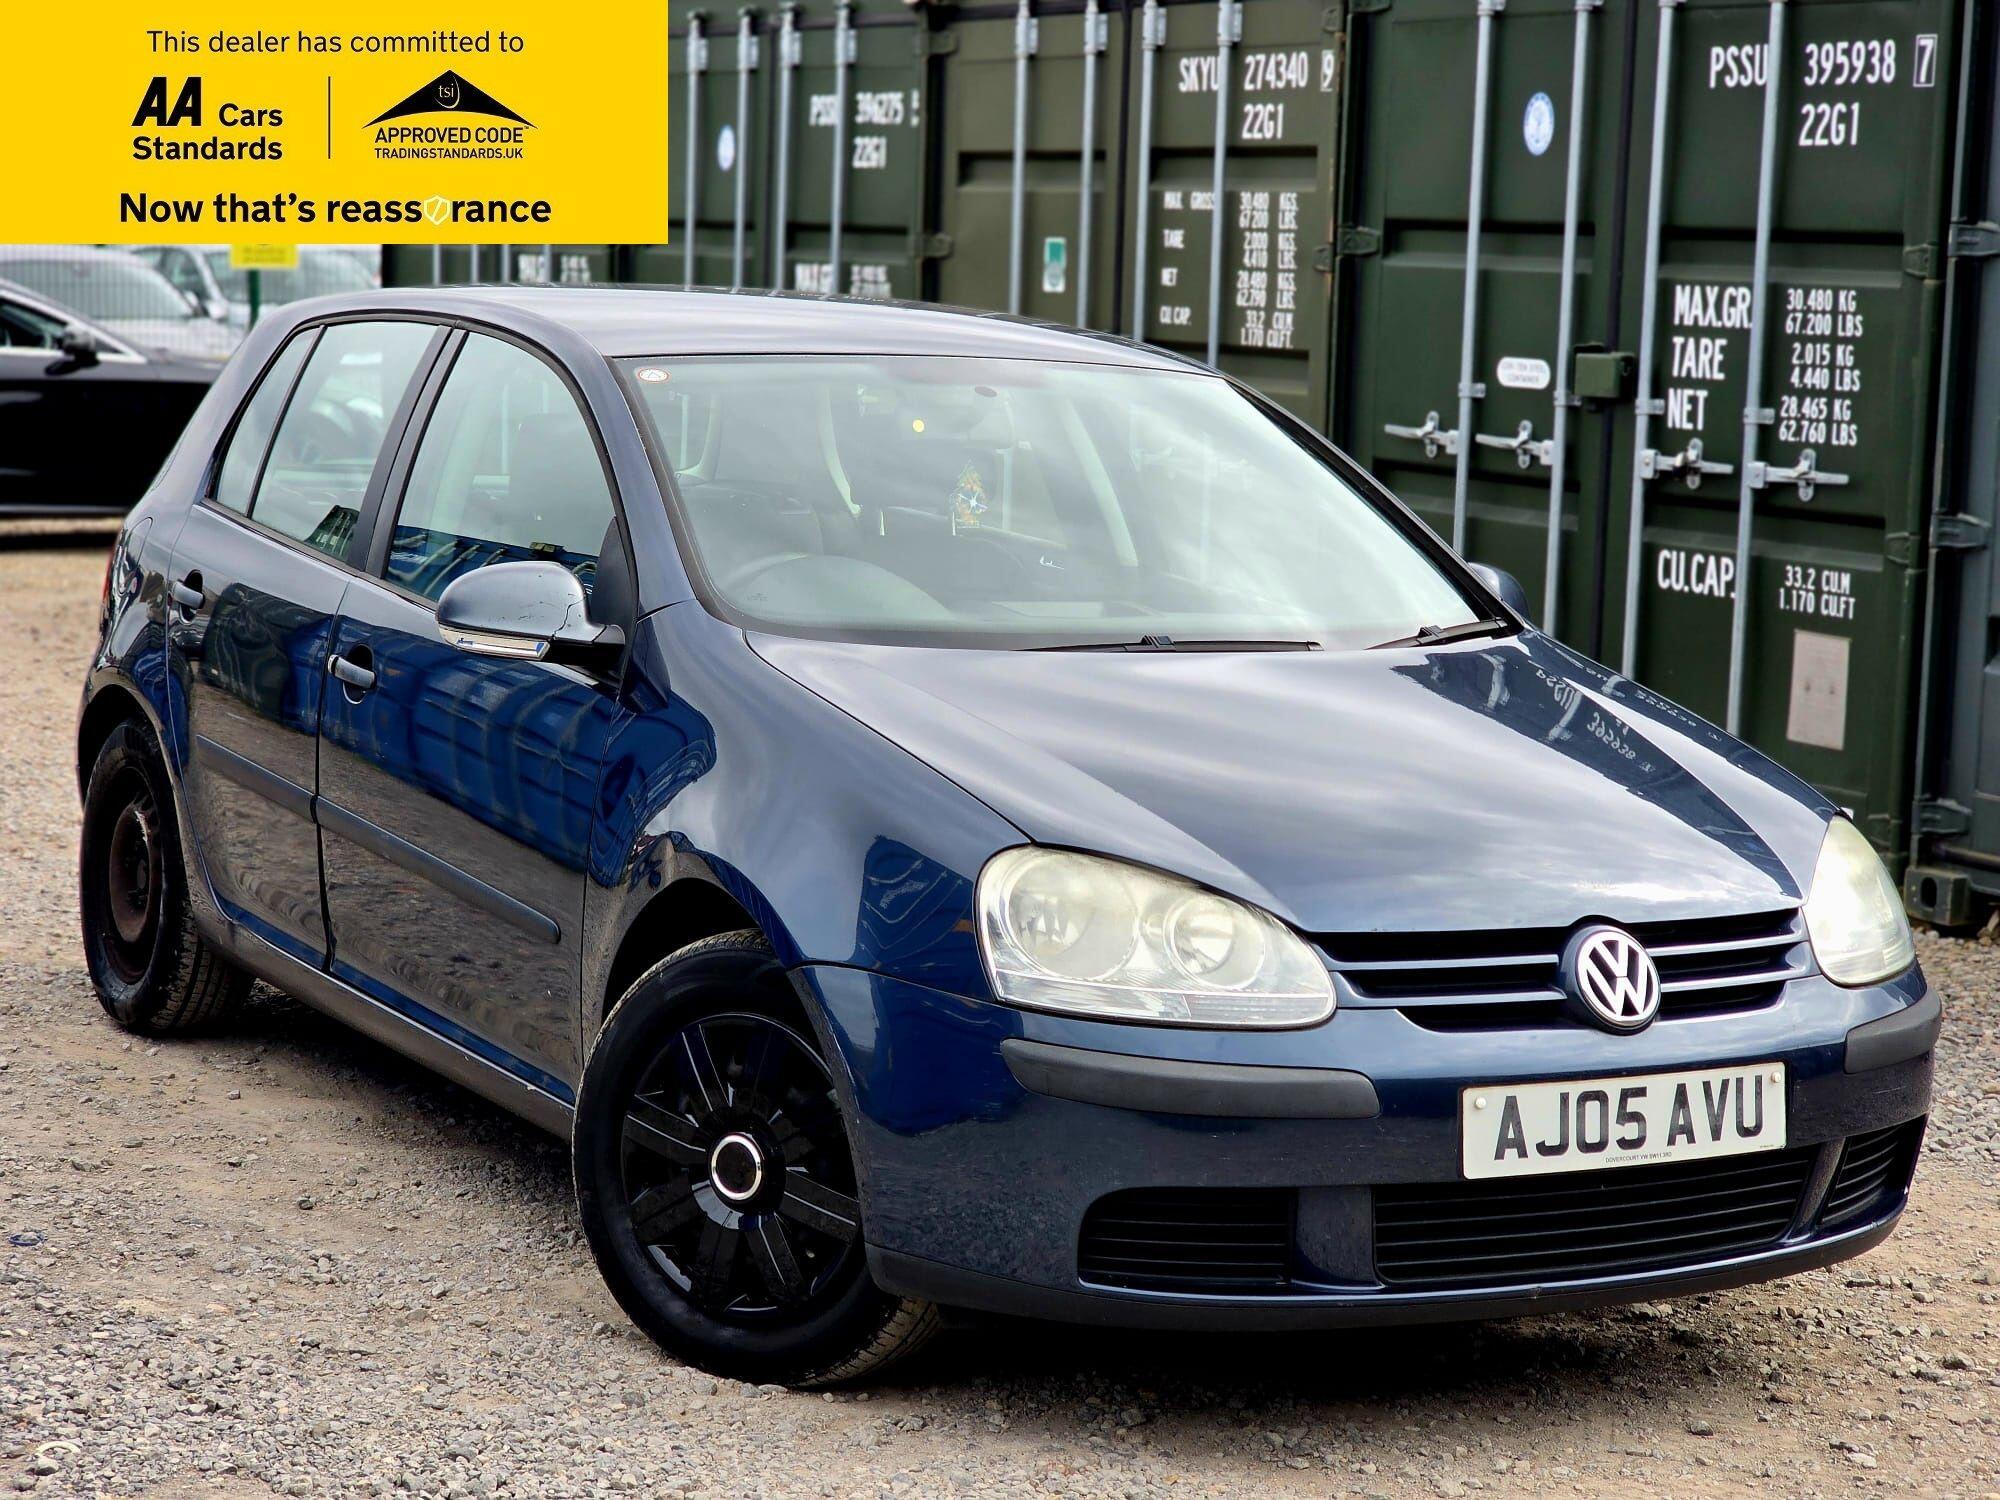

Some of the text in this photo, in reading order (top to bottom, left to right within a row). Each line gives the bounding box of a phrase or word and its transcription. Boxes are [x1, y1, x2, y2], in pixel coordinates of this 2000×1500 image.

[1243, 51, 1308, 91] 274340
[1709, 43, 1769, 88] PSSU
[1804, 39, 1896, 86] 395938
[1241, 103, 1284, 139] 22G1
[1799, 102, 1859, 146] 22G1
[1673, 284, 1857, 328] MAX.GR. 30.480 KG
[1785, 313, 1864, 338] 67.200 LBS
[1671, 335, 1855, 380] TARE 2.015 KG
[1790, 367, 1861, 392] 4.440 LBS
[1667, 387, 1851, 431] NET 28.465 KG
[1778, 420, 1858, 447] 62.760 LBS
[1657, 549, 1736, 599] CU.CAP.
[1785, 564, 1816, 590] 33.2
[1779, 587, 1815, 613] 1.170
[1494, 1075, 1763, 1160] AJ05 AVU
